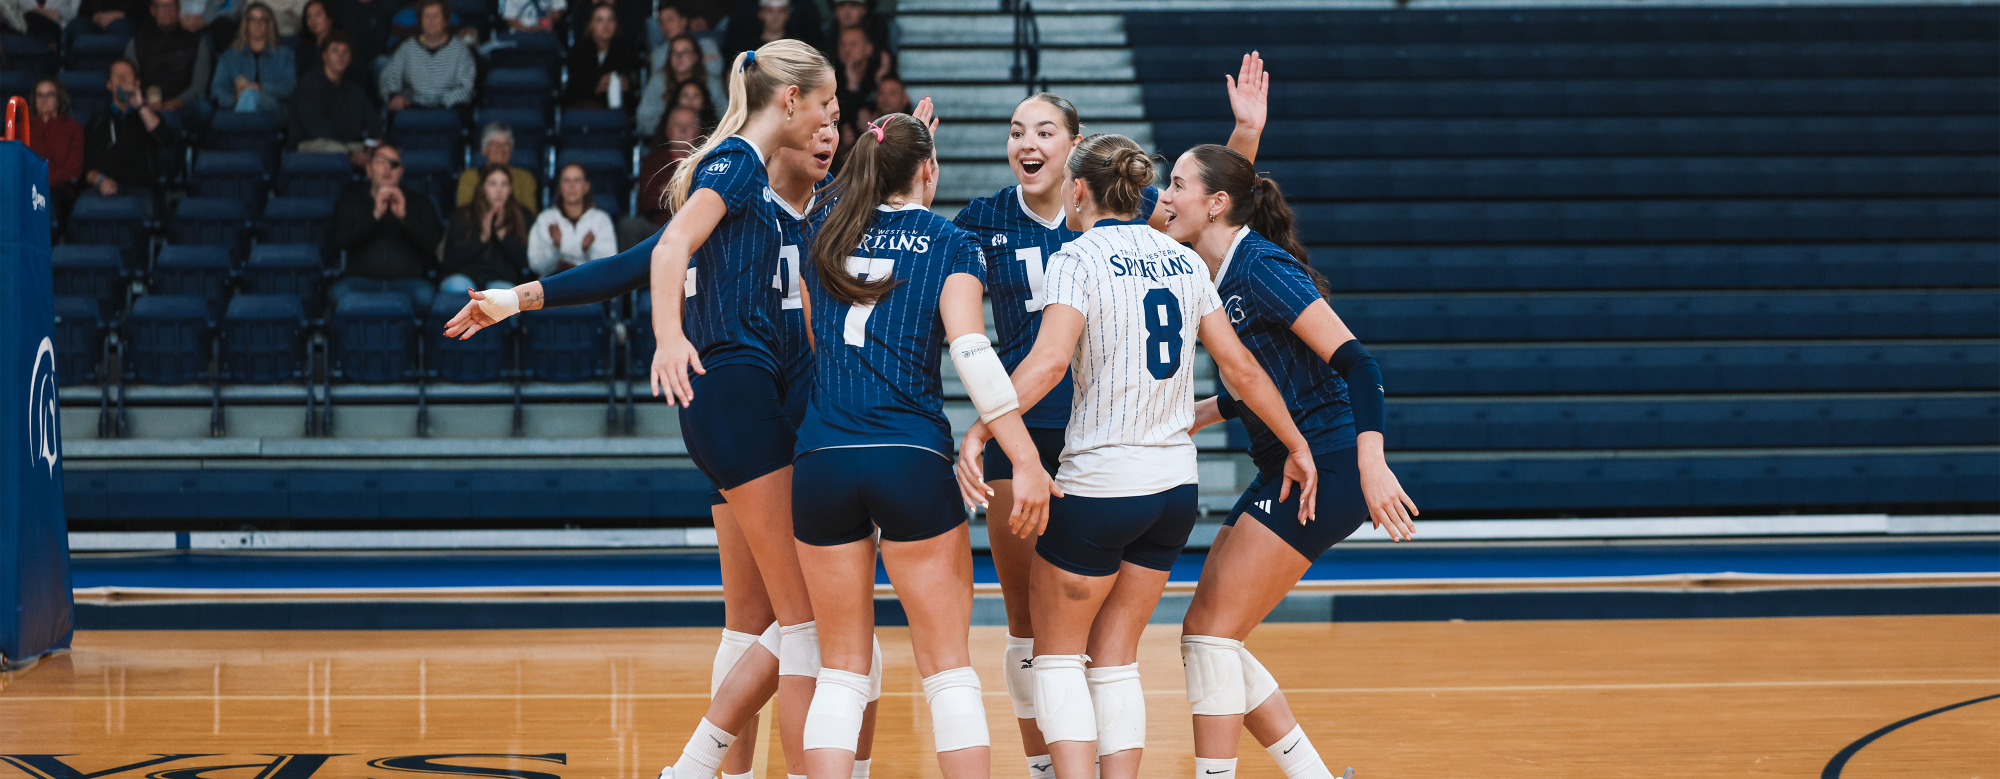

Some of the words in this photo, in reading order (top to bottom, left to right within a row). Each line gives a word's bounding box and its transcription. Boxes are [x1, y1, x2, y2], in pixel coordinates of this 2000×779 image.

[843, 256, 895, 348] 7
[1109, 253, 1194, 283] SPARTANS
[1142, 288, 1183, 380] 8
